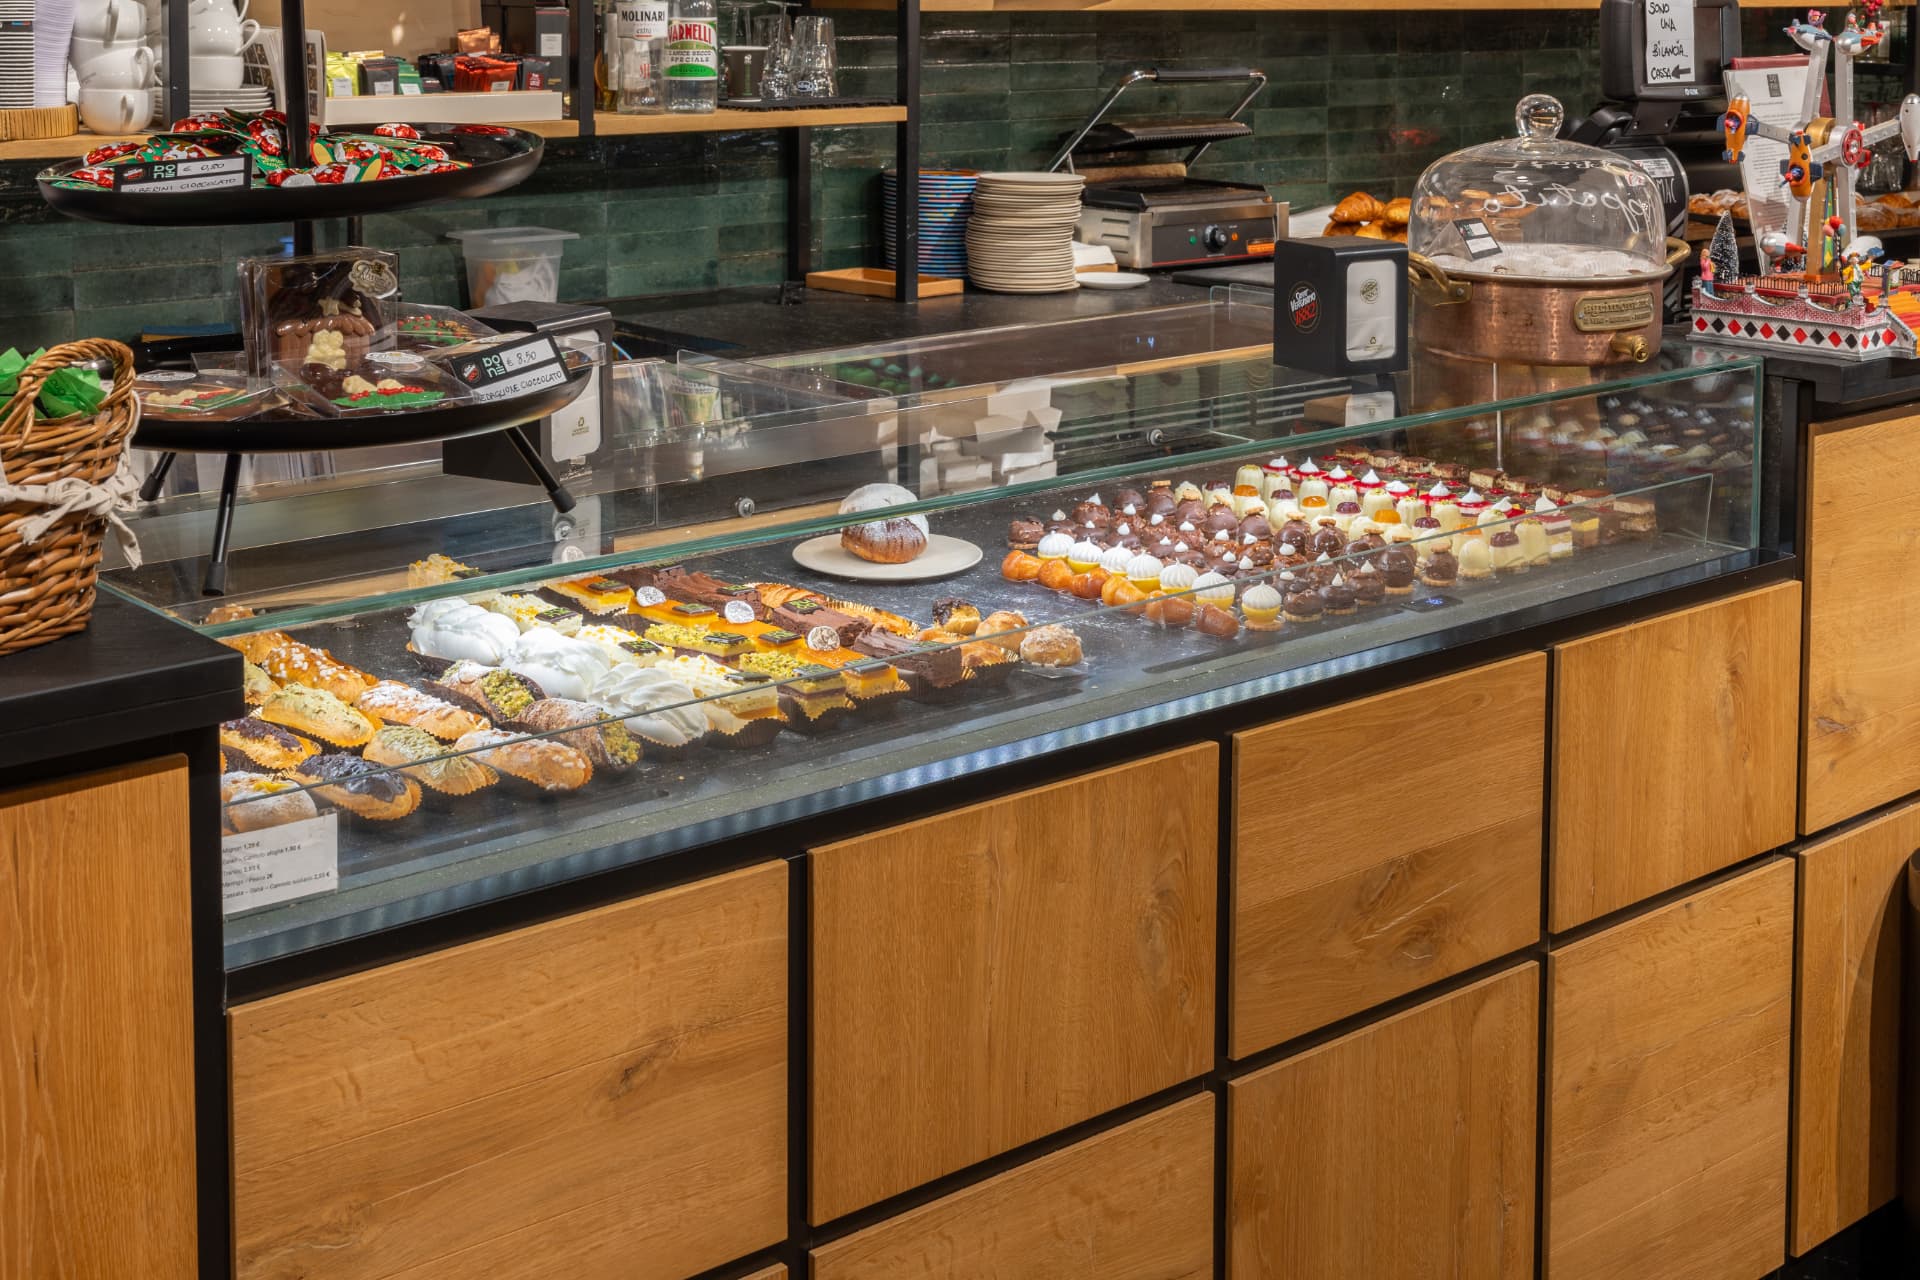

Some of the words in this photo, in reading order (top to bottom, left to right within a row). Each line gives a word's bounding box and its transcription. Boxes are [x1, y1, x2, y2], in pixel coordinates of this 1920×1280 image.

[1648, 2, 1670, 15] SONO
[621, 10, 665, 22] MOLINARI
[1660, 17, 1677, 31] UNA
[668, 23, 712, 44] VARNELLI
[476, 383, 521, 403] EDAGLIONE
[520, 370, 563, 390] CIOCCOLATO
